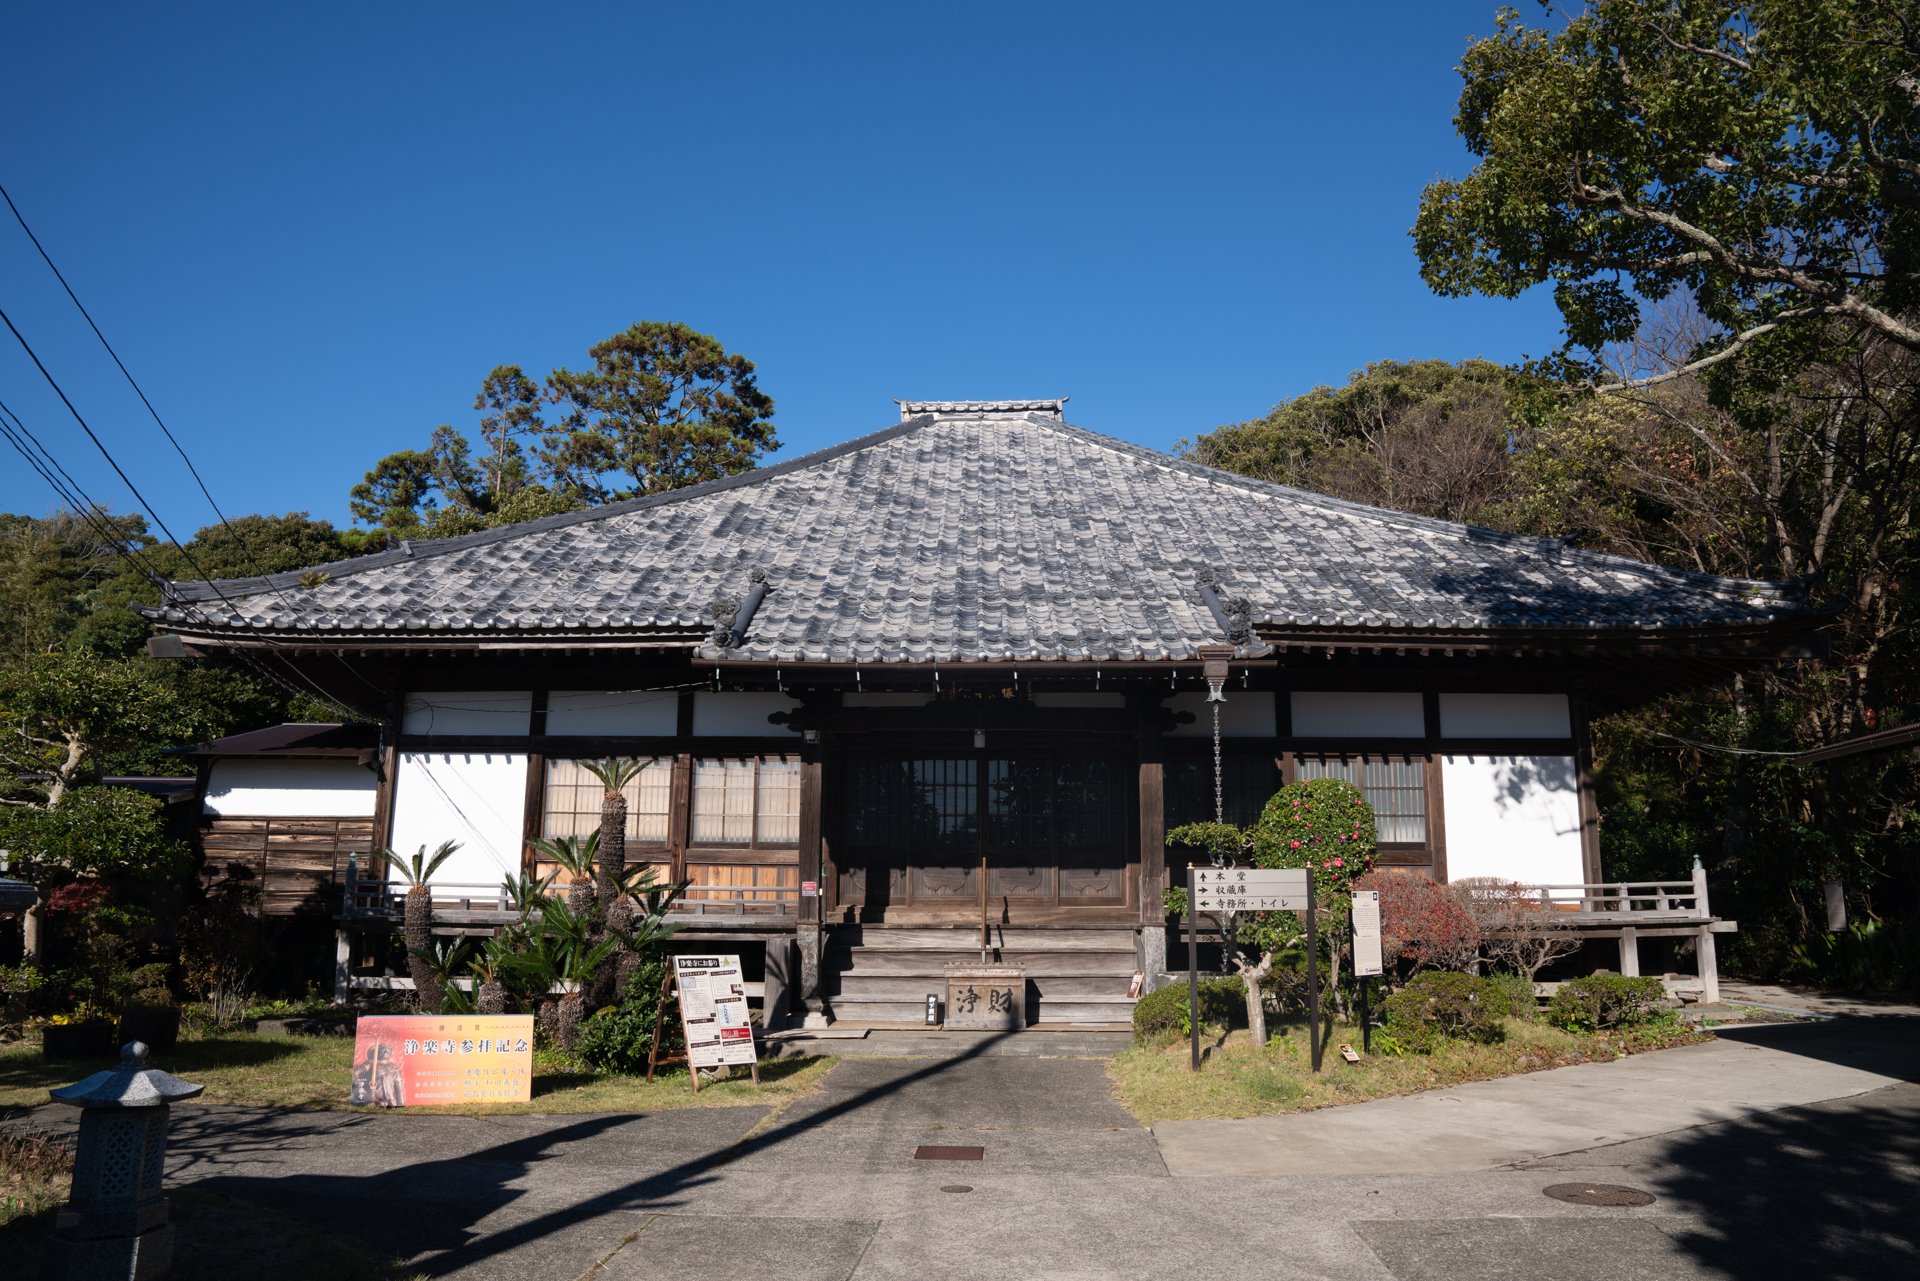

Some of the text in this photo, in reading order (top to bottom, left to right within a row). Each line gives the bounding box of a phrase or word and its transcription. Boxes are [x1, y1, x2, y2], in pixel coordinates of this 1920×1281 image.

[1216, 871, 1246, 881] 本堂
[1216, 885, 1247, 895] 収蔵庫
[404, 1038, 529, 1055] 浄楽寺参拝記念
